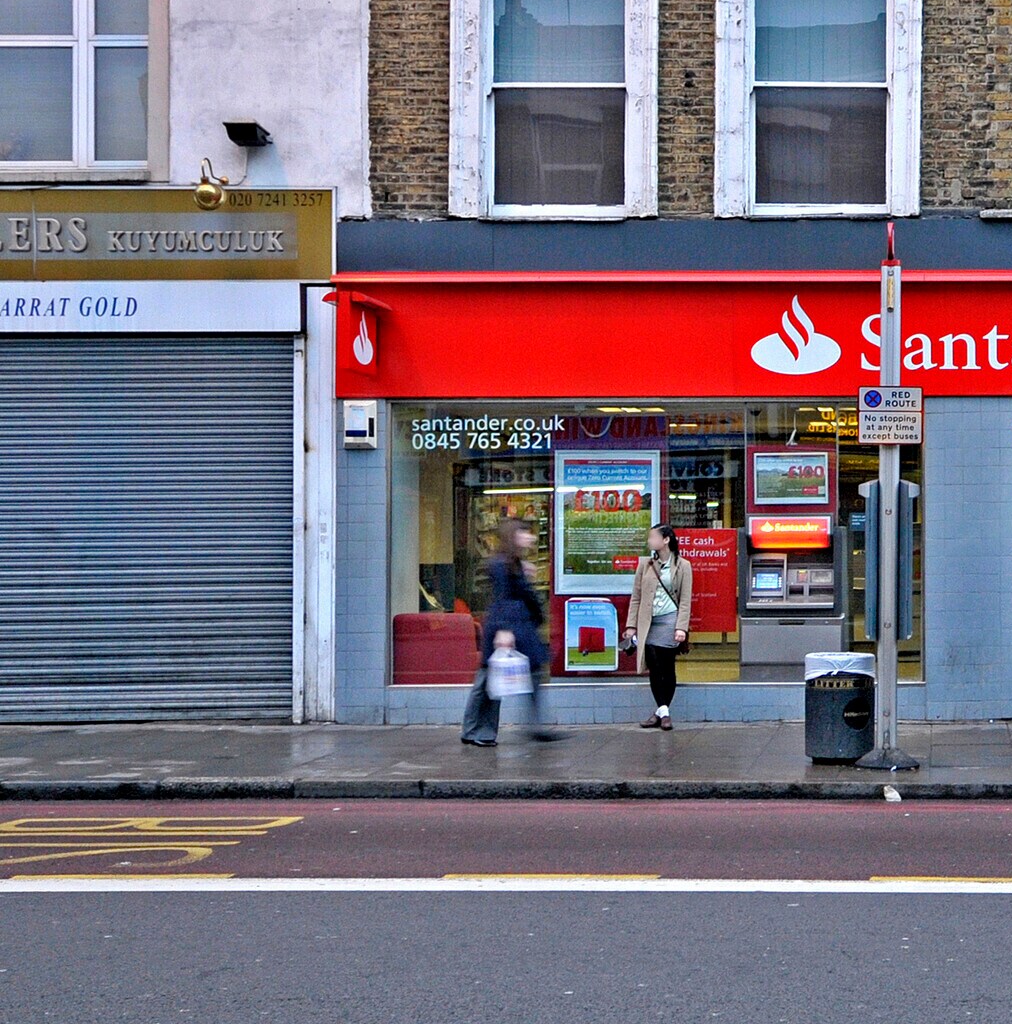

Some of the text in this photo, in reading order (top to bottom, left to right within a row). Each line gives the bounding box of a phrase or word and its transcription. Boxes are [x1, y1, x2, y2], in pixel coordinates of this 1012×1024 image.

[229, 193, 323, 207] 020 7241 3257
[0, 217, 284, 253] ERS KUYUMCULUK
[79, 296, 138, 317] GOLD
[891, 391, 911, 399] RED
[411, 414, 565, 432] santander.co.uk
[880, 415, 917, 424] stopping
[880, 424, 893, 433] any
[411, 433, 552, 450] 0845 765 4321
[862, 432, 919, 441] except buses
[788, 465, 825, 479] £100
[573, 488, 643, 513] £100
[774, 521, 819, 532] Santander
[693, 536, 715, 546] cash
[814, 679, 855, 688] LITTER
